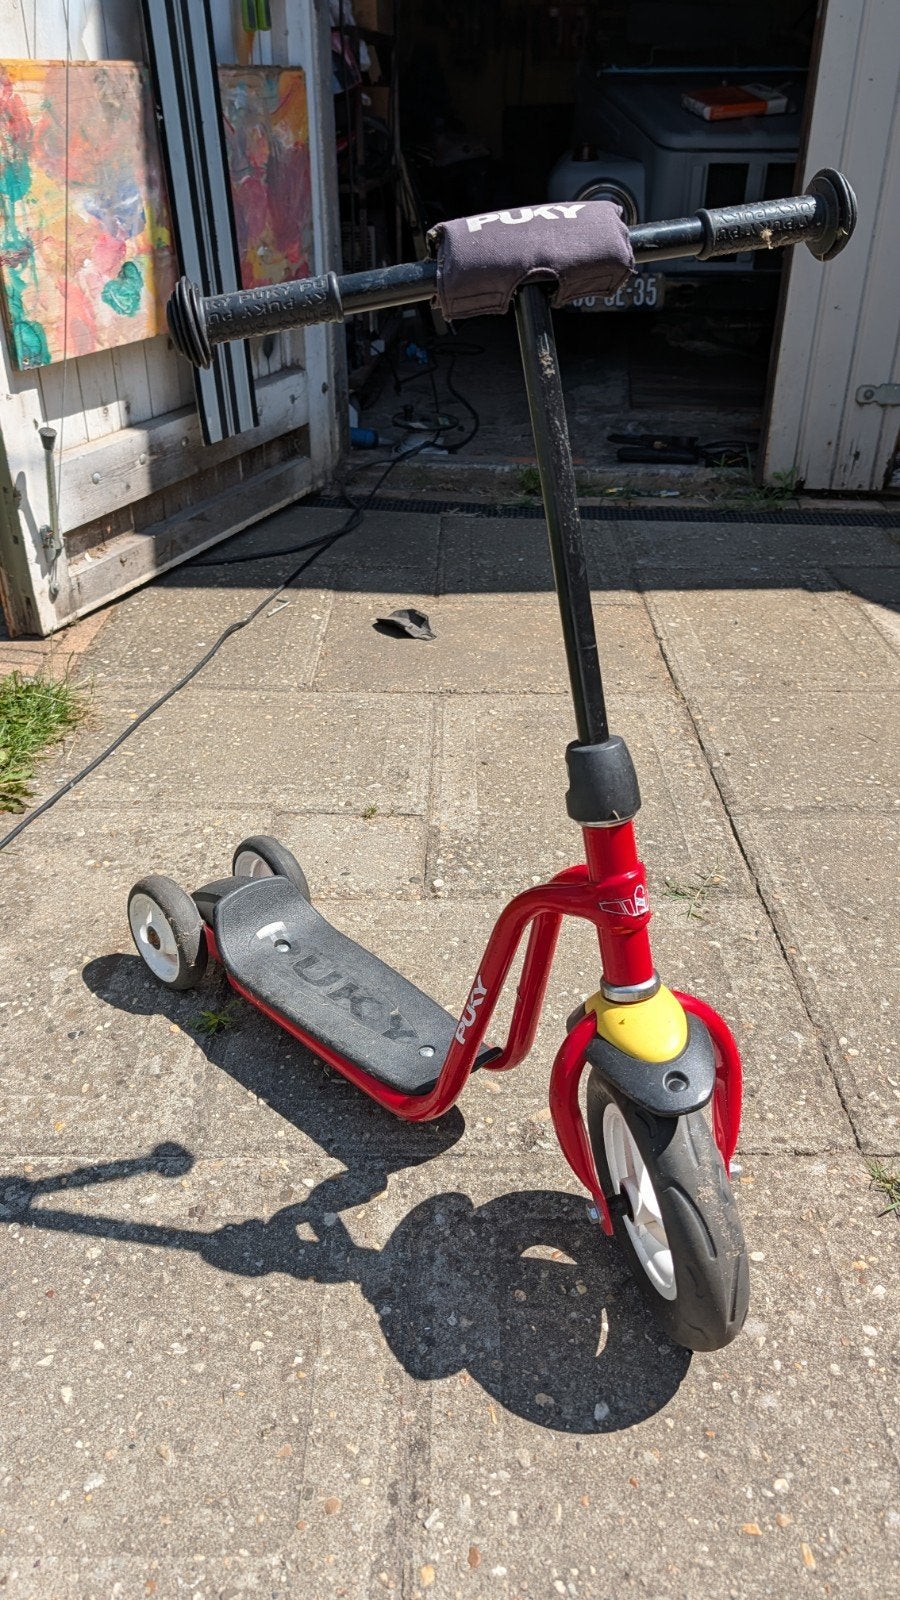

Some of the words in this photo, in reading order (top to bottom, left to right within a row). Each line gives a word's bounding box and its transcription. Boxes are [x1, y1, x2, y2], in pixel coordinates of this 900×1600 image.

[466, 205, 586, 233] PUKY
[238, 285, 293, 304] PUKY
[455, 974, 488, 1045] PUKY
